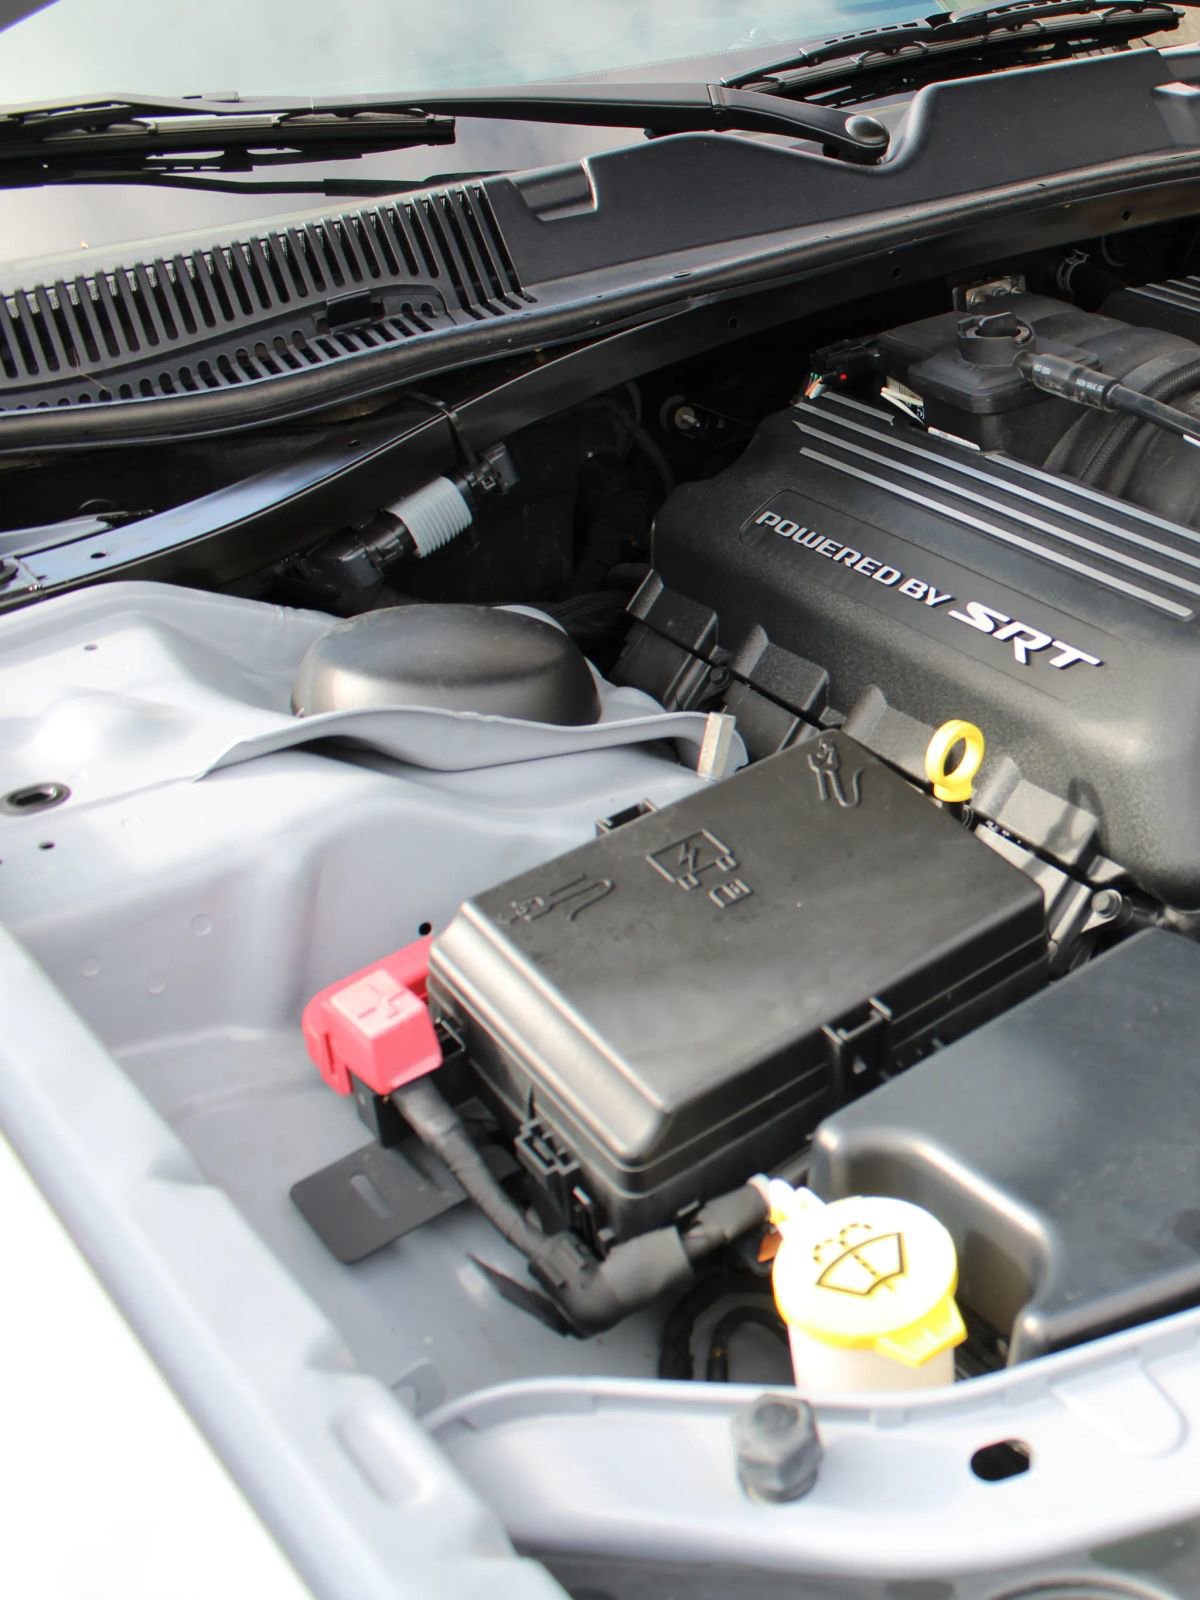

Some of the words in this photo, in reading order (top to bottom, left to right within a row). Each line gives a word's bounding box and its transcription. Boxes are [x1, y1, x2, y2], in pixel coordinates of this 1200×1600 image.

[755, 510, 901, 586] POWERED
[898, 578, 953, 606] BY
[948, 601, 1102, 669] SRT
